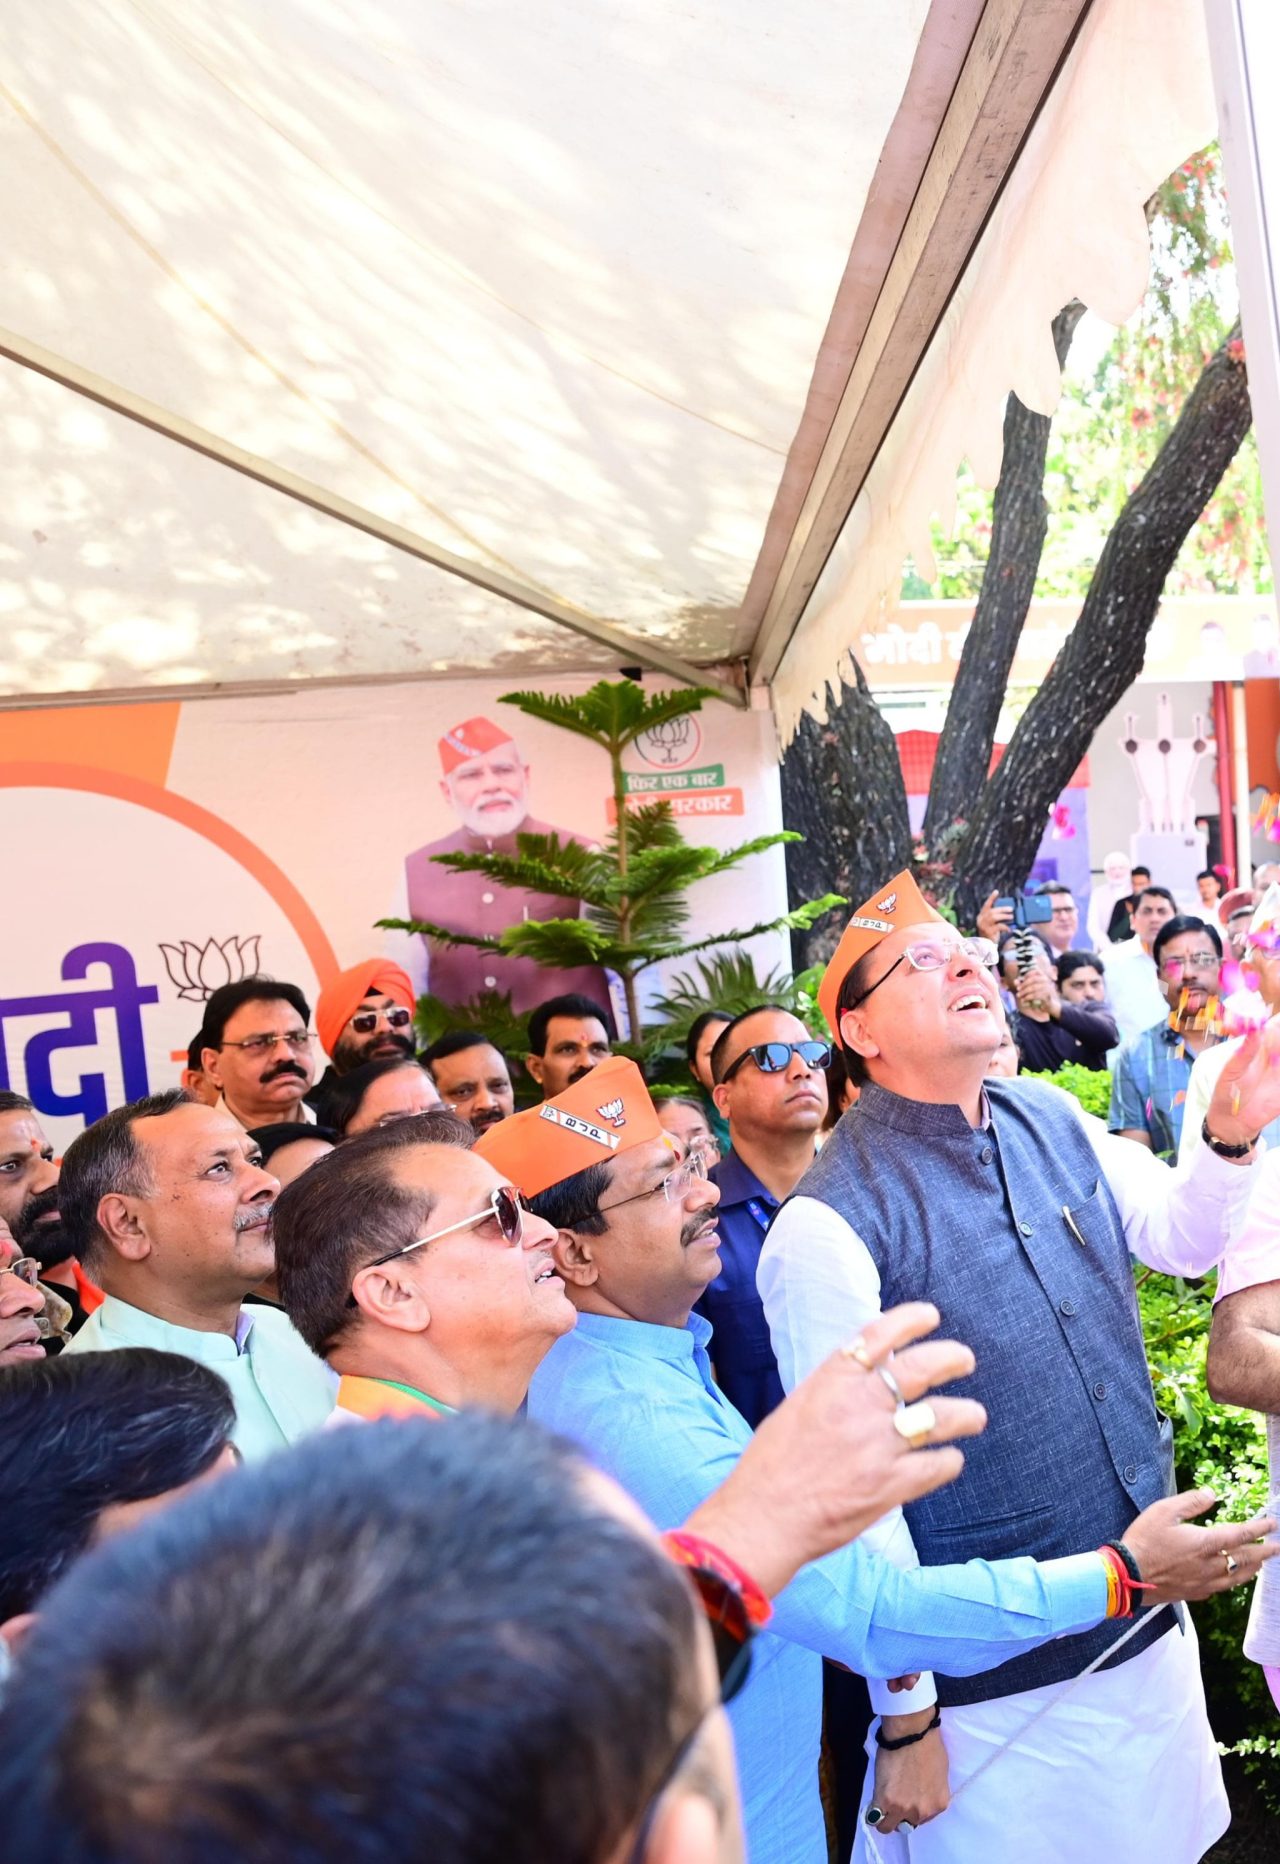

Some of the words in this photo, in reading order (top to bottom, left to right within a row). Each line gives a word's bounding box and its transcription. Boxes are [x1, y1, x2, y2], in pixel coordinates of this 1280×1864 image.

[627, 774, 659, 792] फिर
[661, 774, 688, 789] एक
[690, 771, 718, 786] बार
[565, 1117, 602, 1140] BJP
